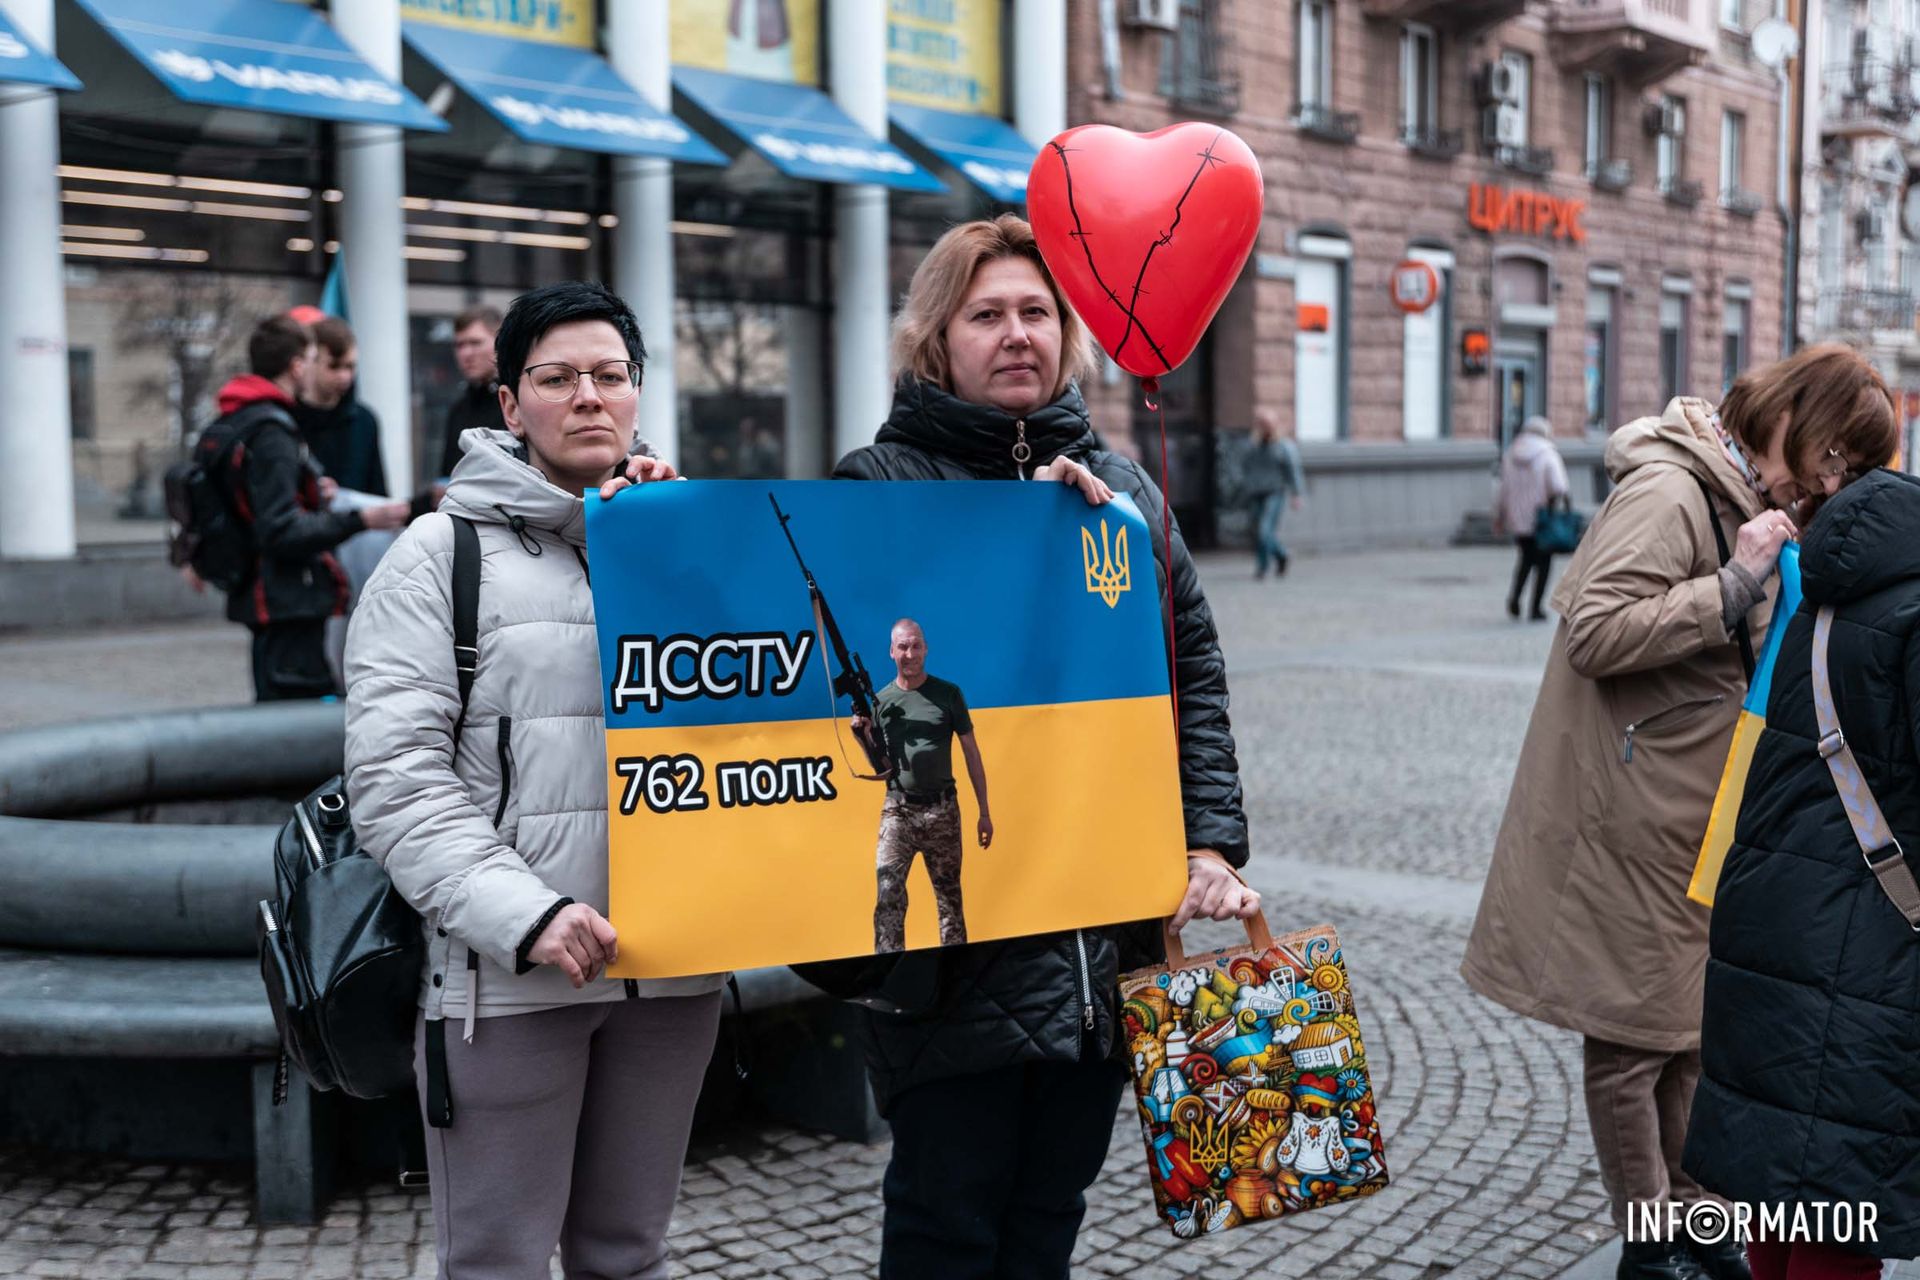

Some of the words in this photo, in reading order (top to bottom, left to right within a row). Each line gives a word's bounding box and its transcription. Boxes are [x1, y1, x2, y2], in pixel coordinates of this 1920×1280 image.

[1468, 182, 1586, 241] ЦИТРУС
[613, 633, 813, 710] ДССТУ
[617, 757, 706, 812] 762
[716, 756, 836, 804] полк
